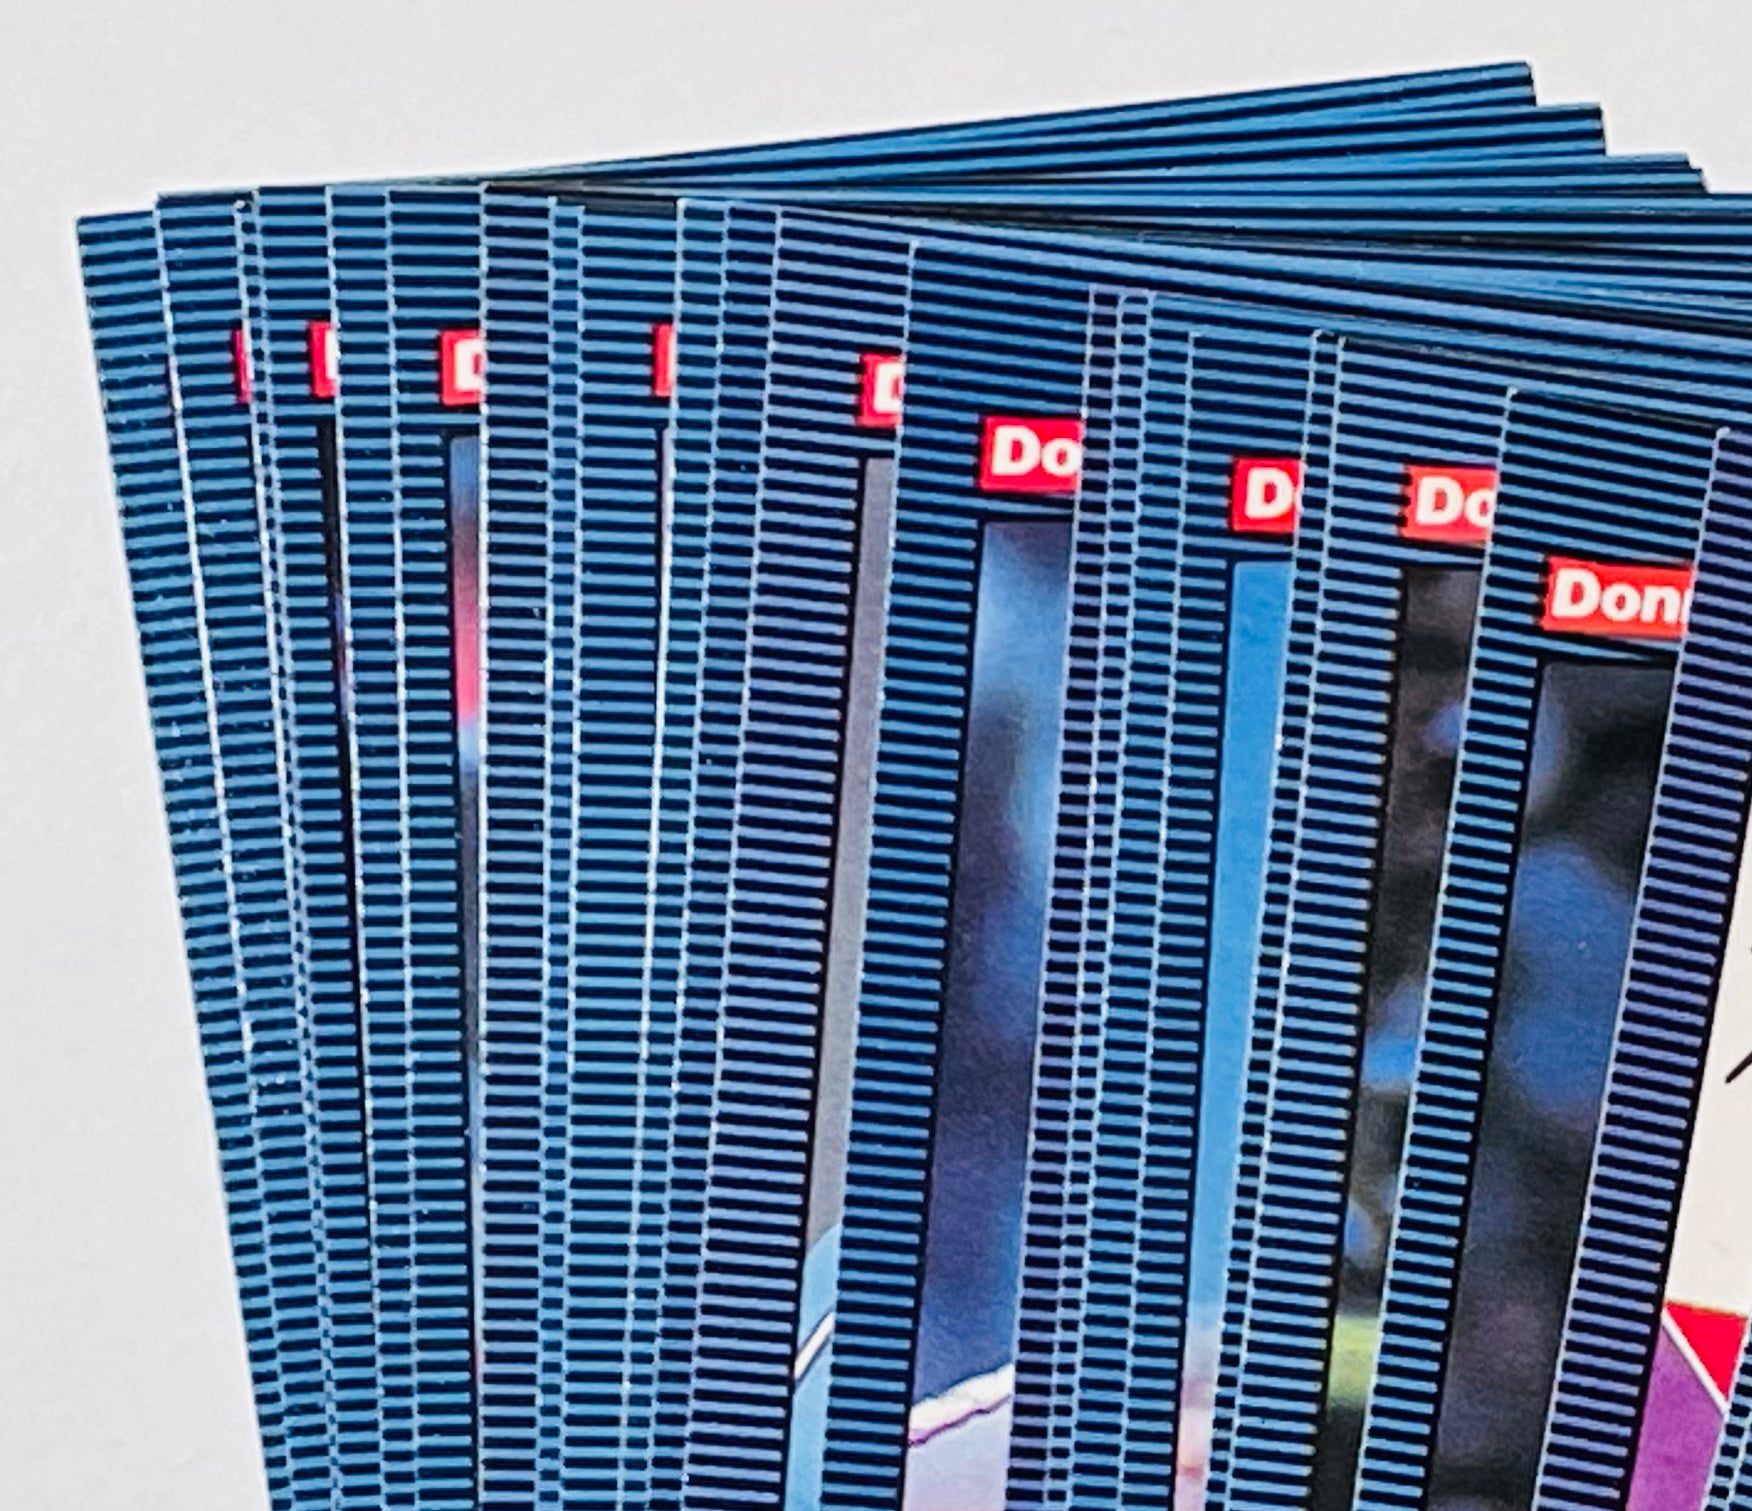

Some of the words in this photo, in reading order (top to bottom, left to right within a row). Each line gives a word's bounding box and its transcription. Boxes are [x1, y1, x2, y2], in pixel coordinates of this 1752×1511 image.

[991, 424, 1084, 477] Do
[1244, 466, 1302, 519] D
[1415, 475, 1497, 529] Do
